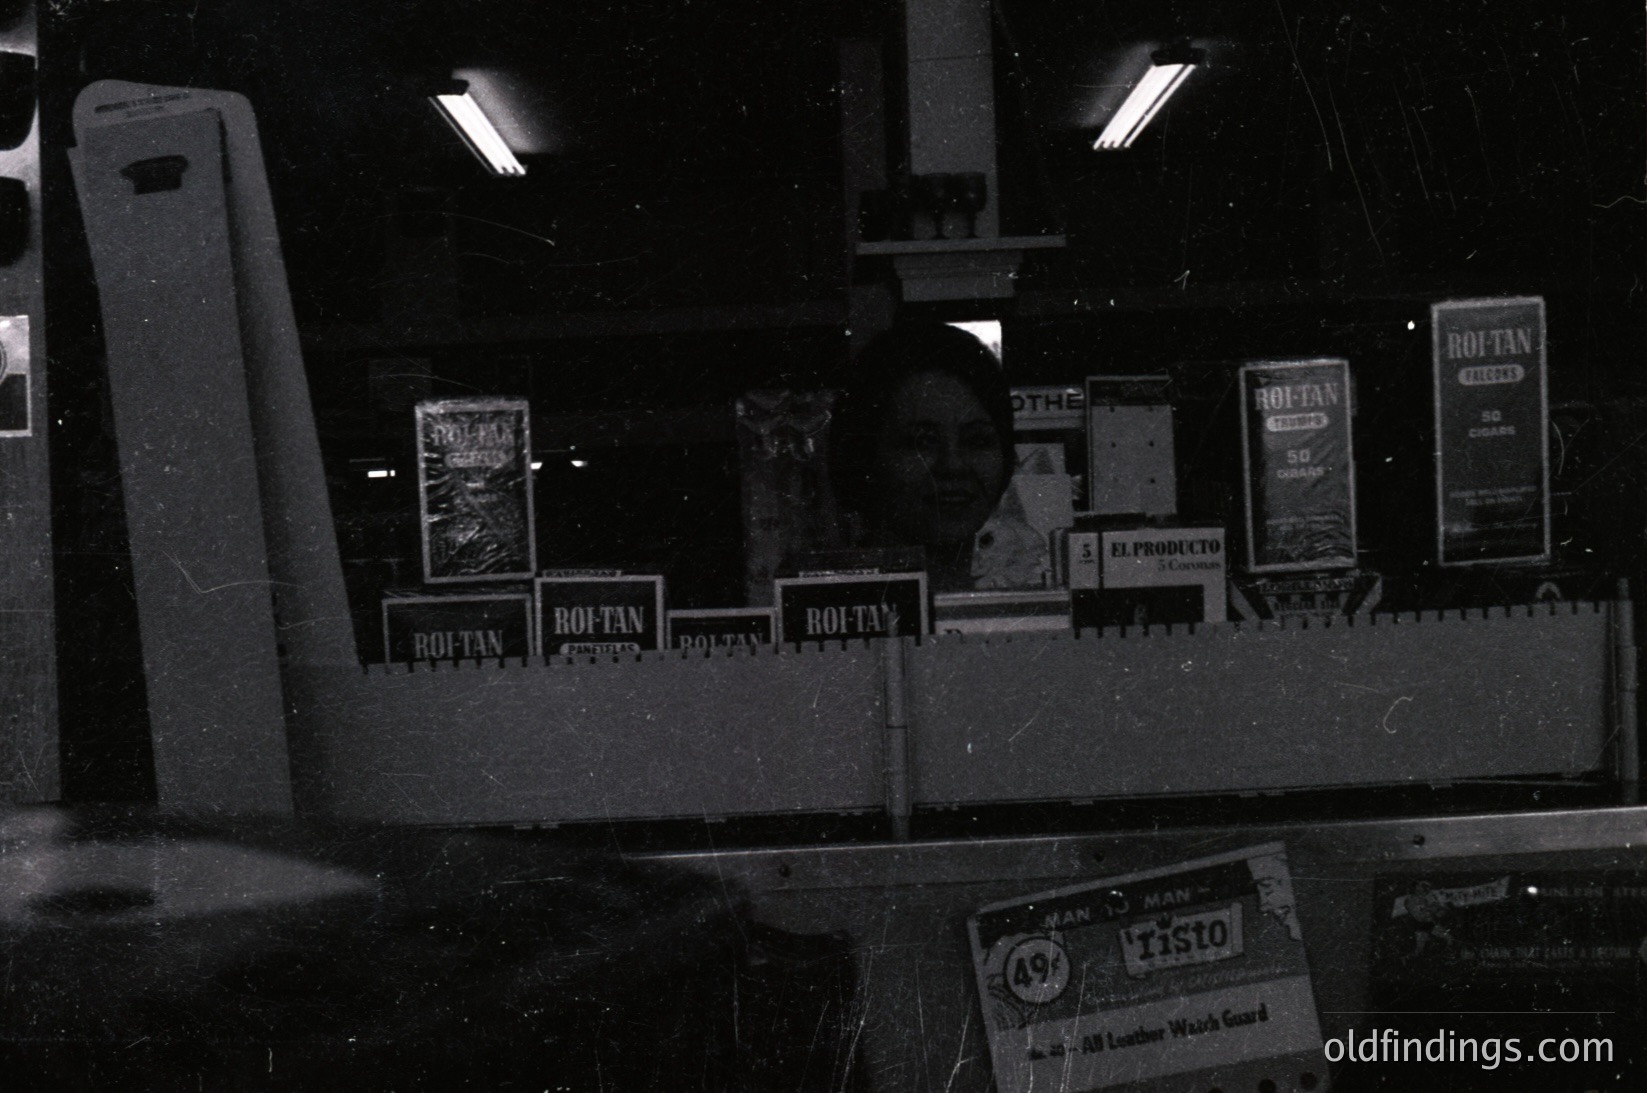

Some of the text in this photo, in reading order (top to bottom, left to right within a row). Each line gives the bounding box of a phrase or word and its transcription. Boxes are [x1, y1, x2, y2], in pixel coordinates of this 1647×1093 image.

[1449, 329, 1532, 359] ROI-TAN
[1254, 382, 1338, 411] ROI-TAN
[1481, 410, 1502, 423] 50
[1468, 425, 1516, 438] CIGARS
[1286, 449, 1311, 464] 50
[1276, 466, 1325, 480] CIGARS
[1082, 543, 1092, 558] 5
[1111, 538, 1221, 558] EL PRODUCTO
[1158, 558, 1221, 571] 5 Coronas
[554, 605, 645, 635] ROI-TAN
[414, 629, 503, 659] ROI-TAN
[1043, 907, 1090, 929] MAN
[1144, 888, 1191, 909] MAN
[1014, 951, 1061, 988] 49¢
[1081, 1033, 1104, 1055] All
[1107, 1025, 1165, 1050] Leather
[1168, 1013, 1220, 1038] Watch
[1221, 1002, 1269, 1029] Guard
